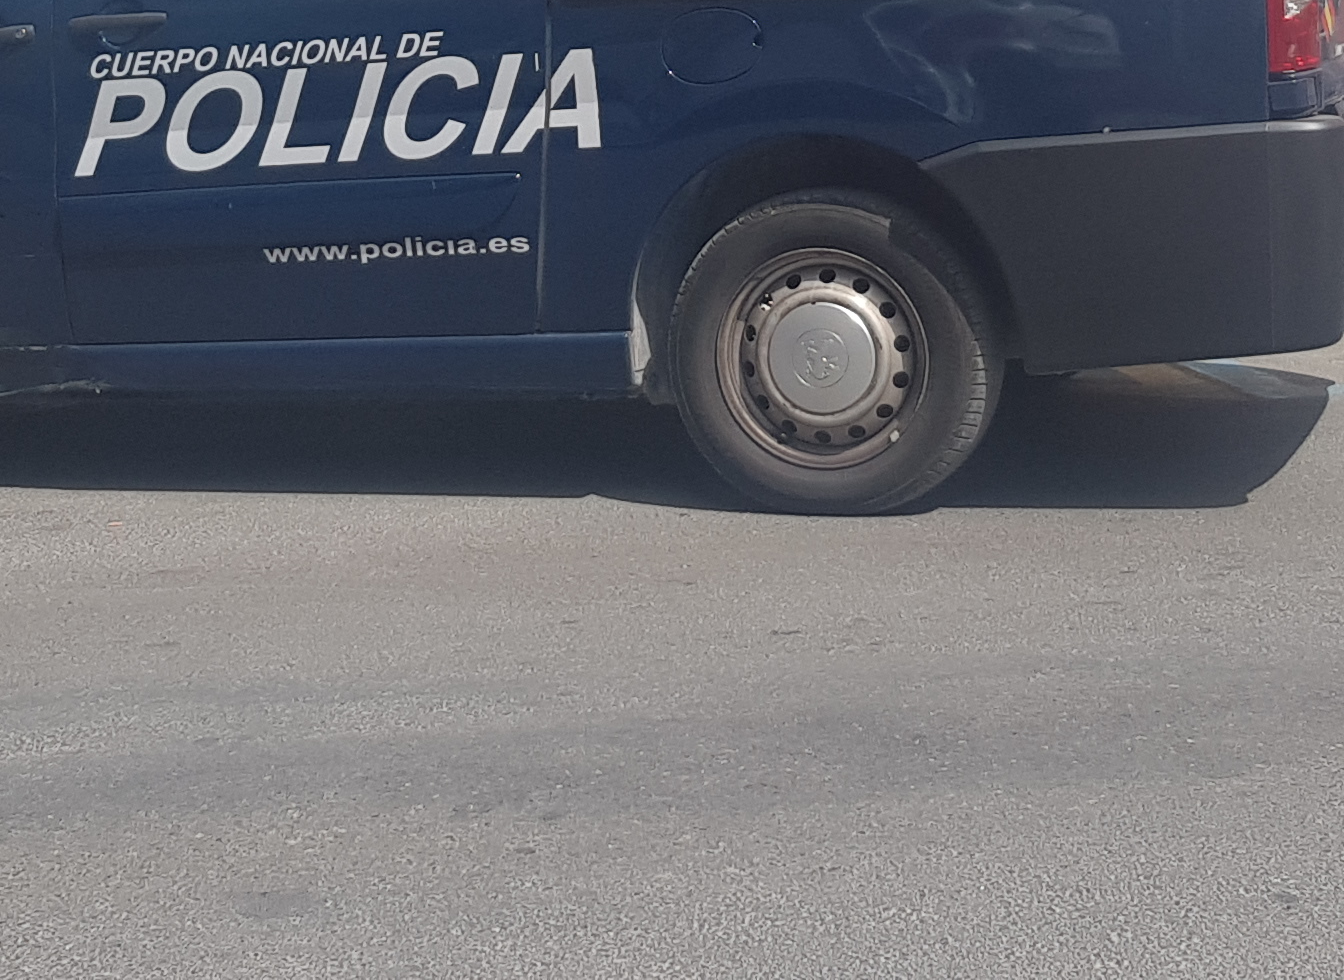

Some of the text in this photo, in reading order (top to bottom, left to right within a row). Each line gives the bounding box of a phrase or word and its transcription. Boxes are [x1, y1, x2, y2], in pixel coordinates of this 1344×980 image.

[90, 31, 444, 79] CUERPO NACIONAL DE
[74, 47, 602, 178] POLICIA
[262, 234, 531, 264] www.policia.es
